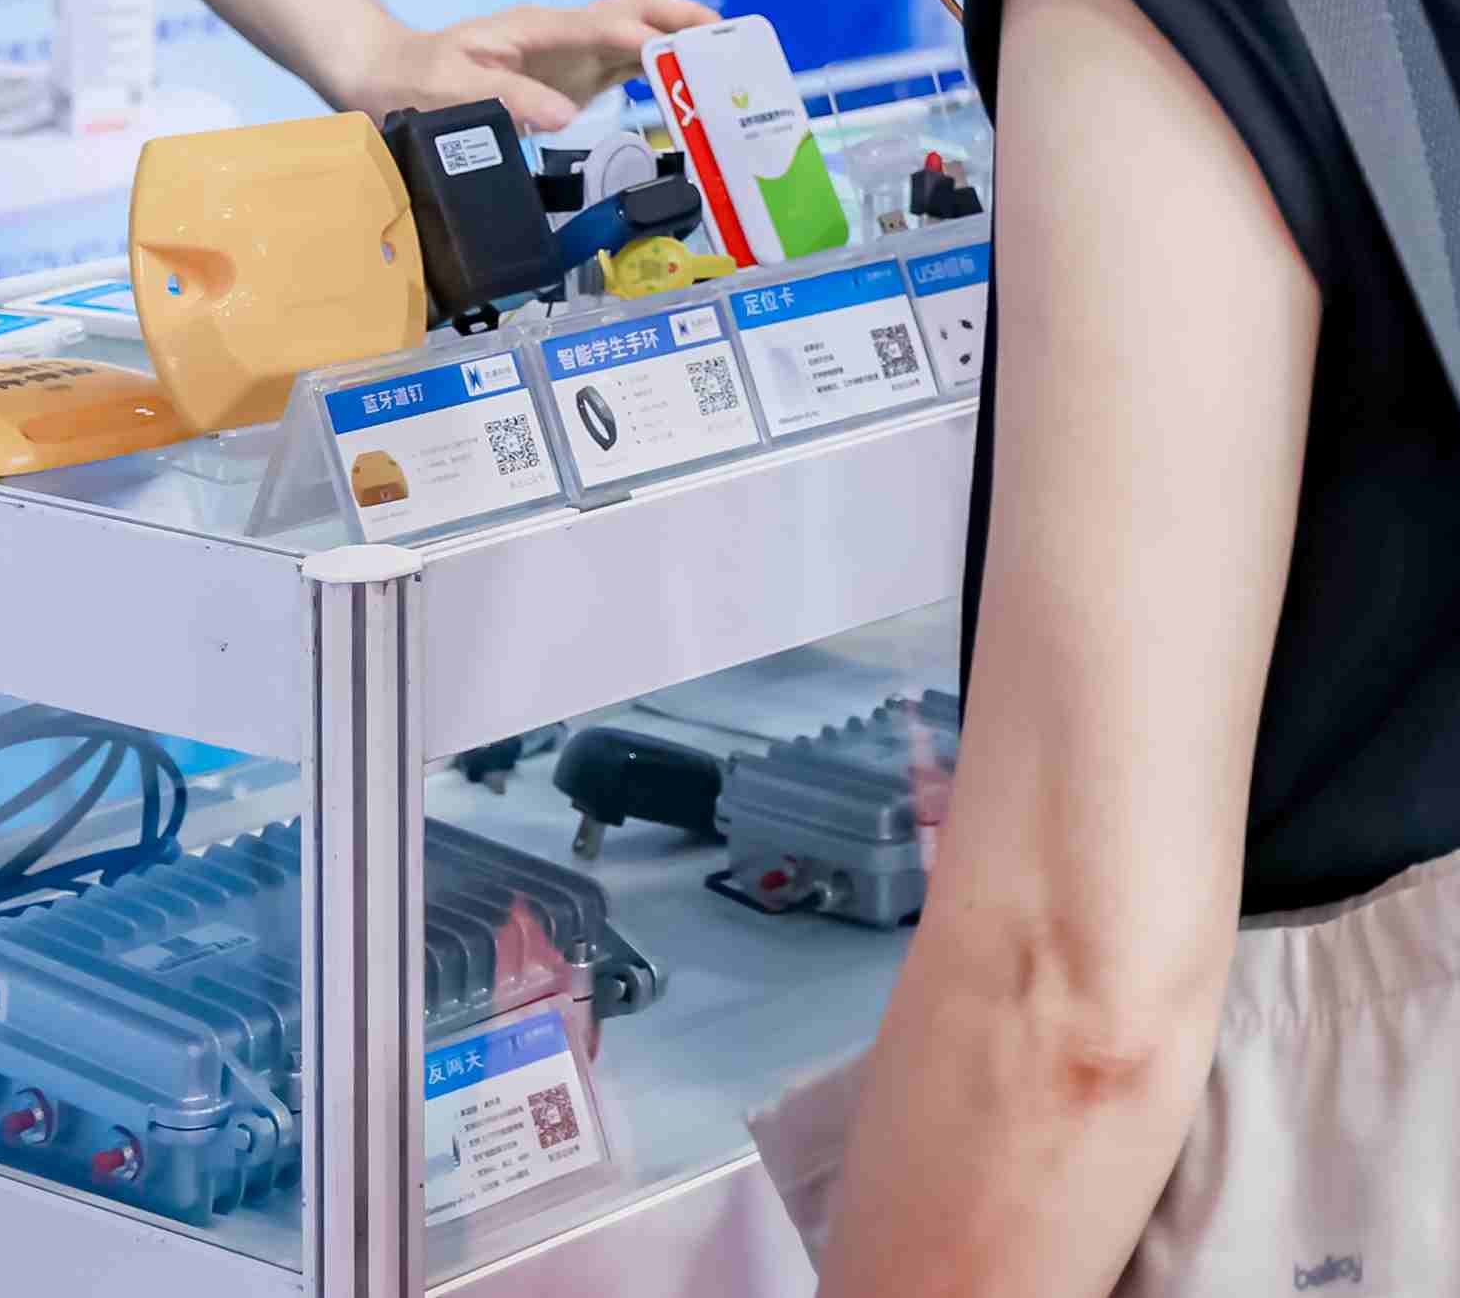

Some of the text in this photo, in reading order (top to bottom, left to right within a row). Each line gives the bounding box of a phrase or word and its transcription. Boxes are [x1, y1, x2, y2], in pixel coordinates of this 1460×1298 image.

[742, 286, 796, 317] 定位卡
[556, 327, 660, 371] 智能学生手环
[361, 382, 427, 416] 蓝牙道钉
